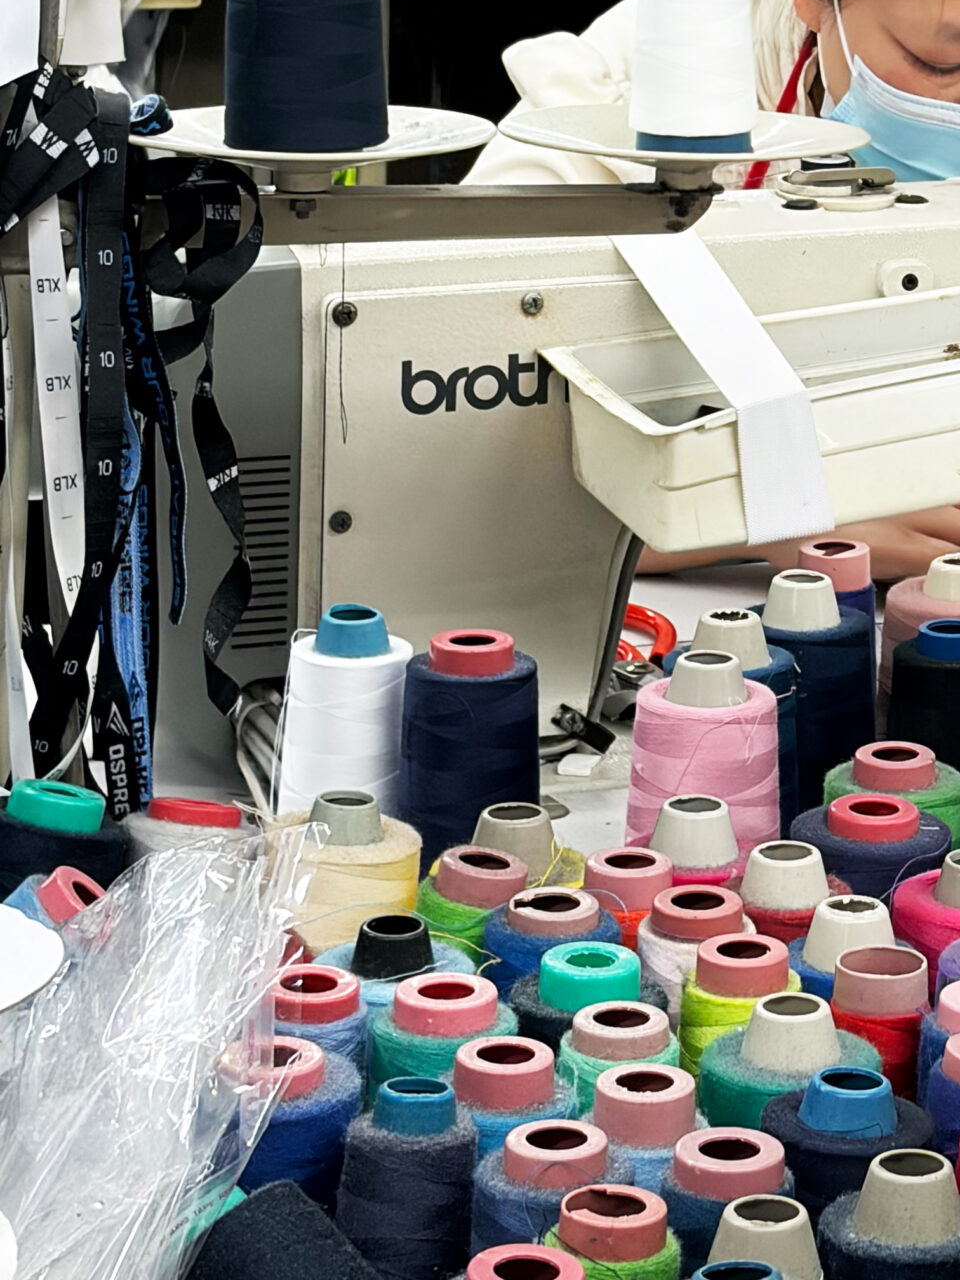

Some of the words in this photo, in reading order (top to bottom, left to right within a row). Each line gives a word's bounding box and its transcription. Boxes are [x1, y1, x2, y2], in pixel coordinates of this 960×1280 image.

[102, 147, 118, 164] 10
[97, 249, 113, 266] 10
[36, 277, 61, 293] XLB
[99, 351, 115, 368] 10
[45, 374, 71, 392] XLB
[97, 460, 113, 476] 10
[53, 473, 78, 491] XLB
[91, 561, 103, 578] 10
[62, 659, 79, 676] 10
[34, 739, 49, 753] 10
